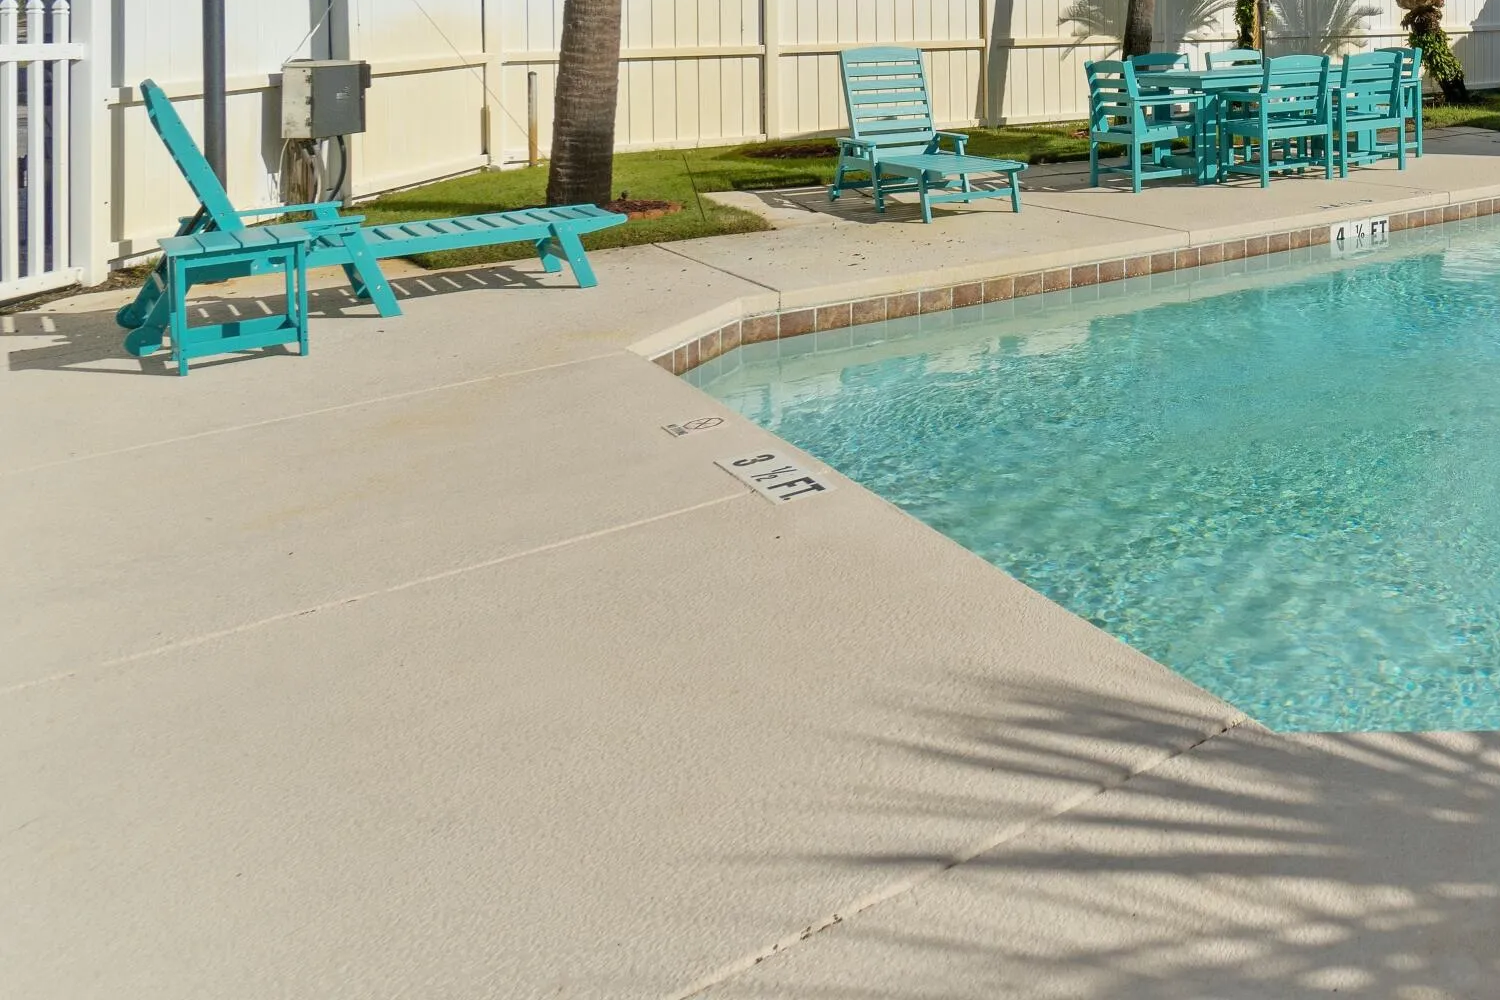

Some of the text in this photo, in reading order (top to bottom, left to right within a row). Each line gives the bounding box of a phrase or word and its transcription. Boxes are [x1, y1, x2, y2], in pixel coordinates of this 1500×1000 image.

[1336, 226, 1345, 241] 4
[1371, 219, 1387, 236] FT
[732, 453, 776, 467] 3
